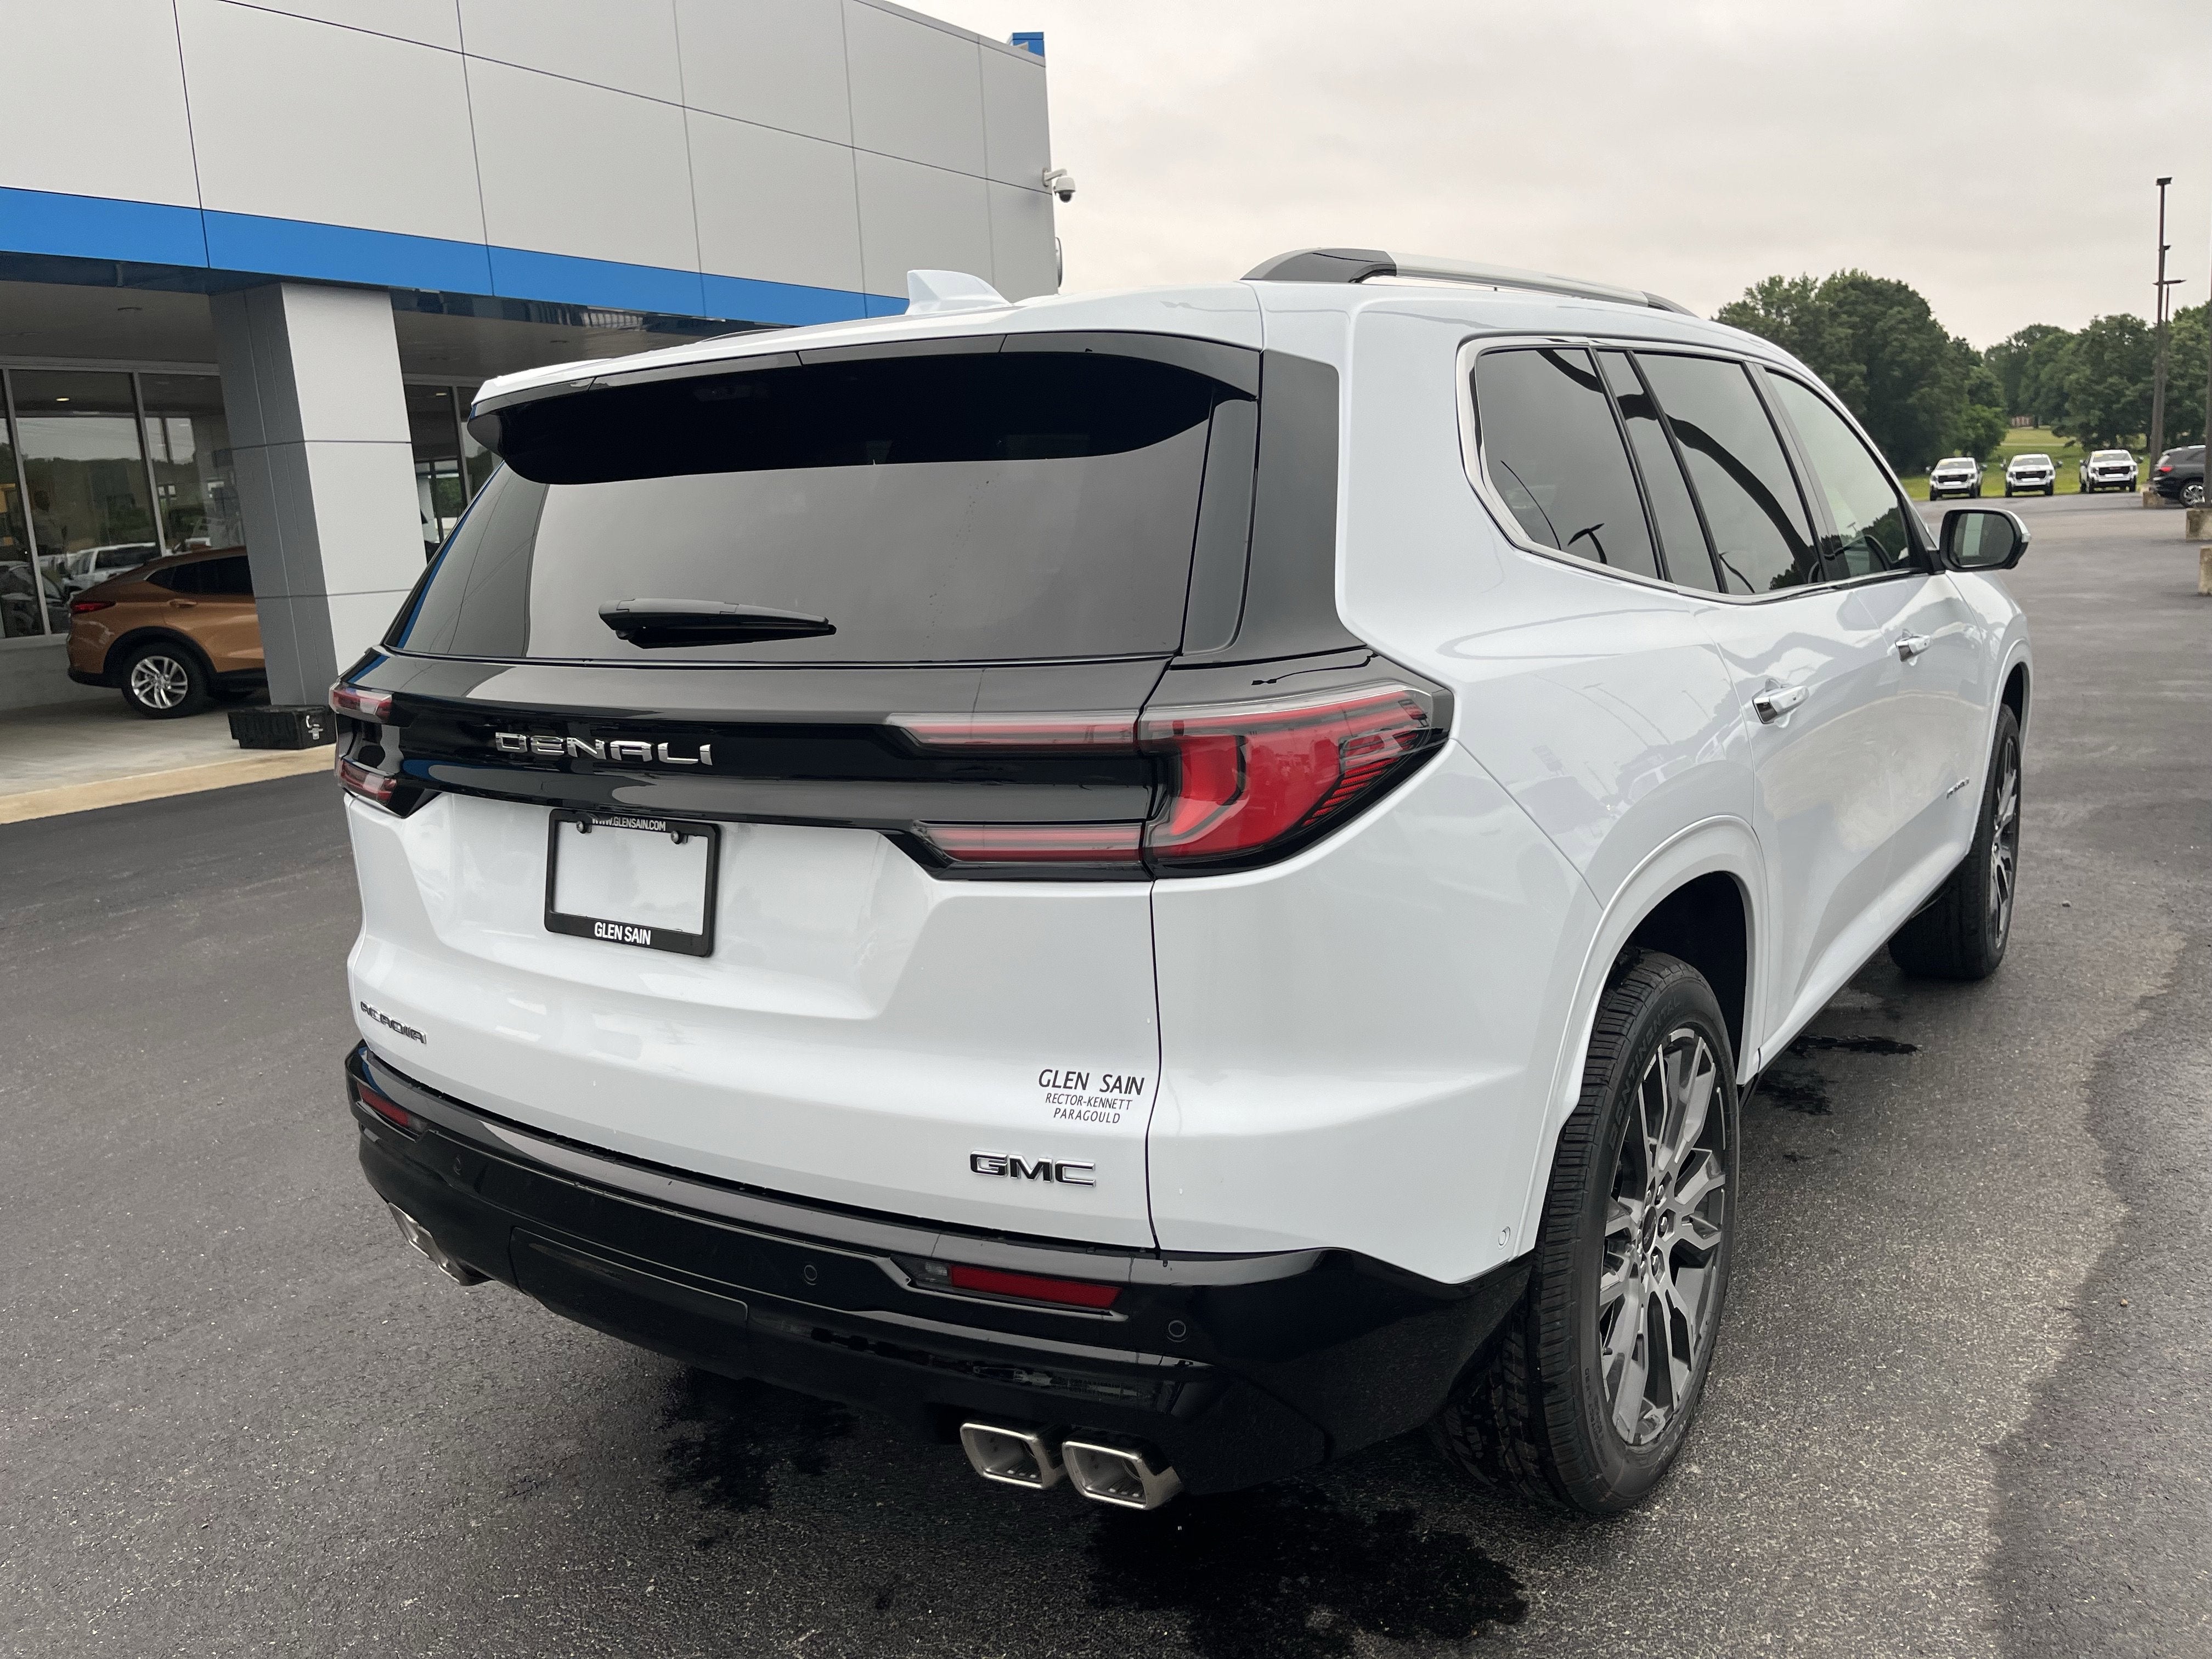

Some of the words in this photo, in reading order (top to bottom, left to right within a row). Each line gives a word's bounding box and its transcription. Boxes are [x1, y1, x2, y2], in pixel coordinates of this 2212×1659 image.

[495, 732, 713, 766] DENALI
[594, 922, 623, 940] GLEN
[624, 927, 651, 945] SAIN
[360, 1001, 427, 1044] ACADIA
[1039, 1069, 1090, 1090] GLEN
[1099, 1074, 1145, 1095] SAIN
[1045, 1093, 1133, 1110] RECTOR-KENNETT
[1053, 1108, 1120, 1124] PARAGOULD
[970, 1150, 1096, 1187] GMC
